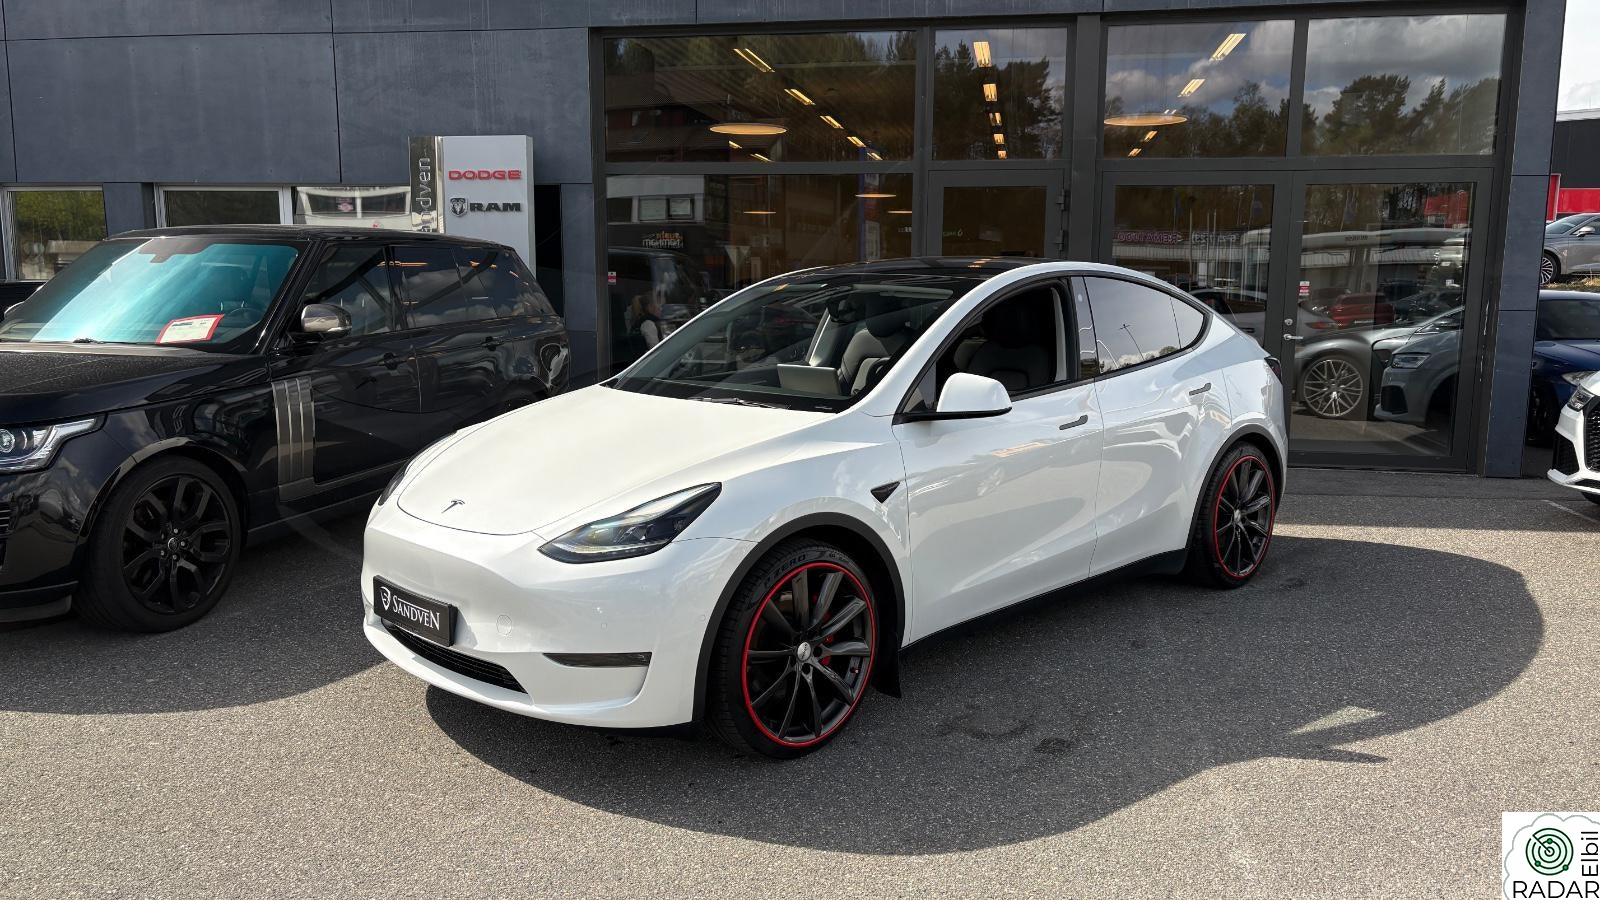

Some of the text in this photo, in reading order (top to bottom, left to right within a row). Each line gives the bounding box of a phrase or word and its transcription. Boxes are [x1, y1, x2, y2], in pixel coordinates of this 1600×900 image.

[448, 170, 522, 180] DODGE
[416, 158, 432, 233] andven
[469, 202, 522, 212] RAM
